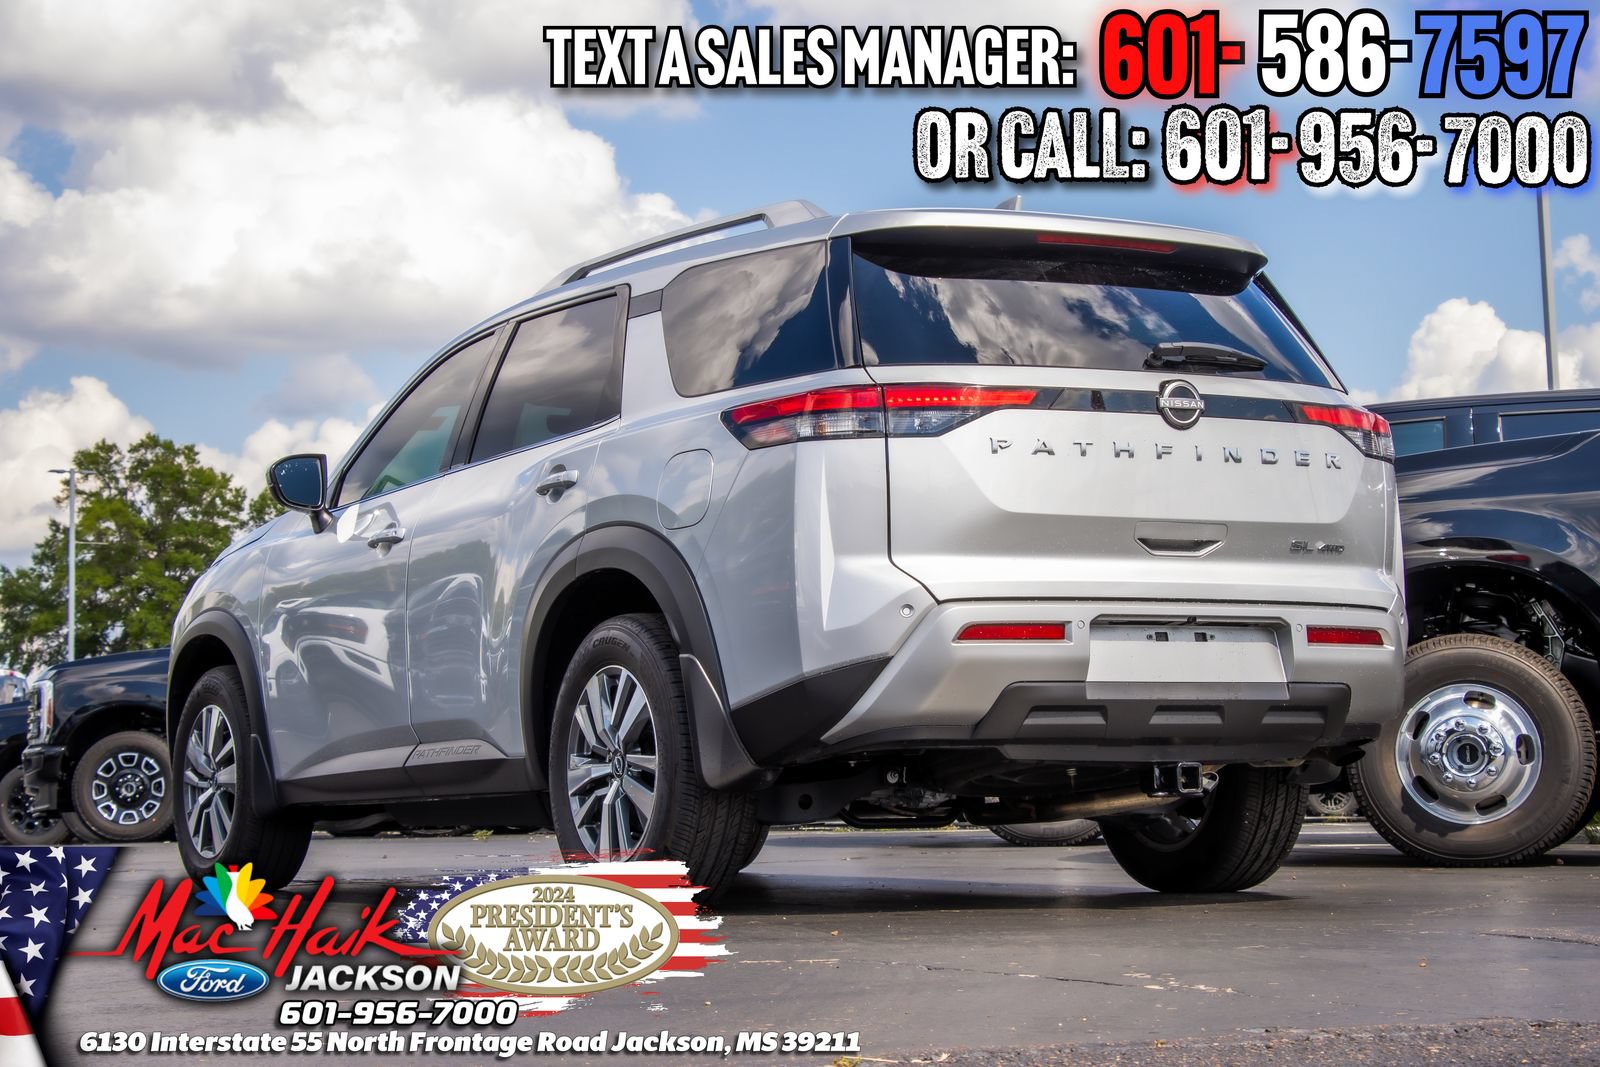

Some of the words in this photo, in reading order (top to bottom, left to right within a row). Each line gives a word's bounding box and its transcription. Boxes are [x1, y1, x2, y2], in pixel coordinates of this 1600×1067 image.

[1160, 398, 1205, 409] NISSAN
[989, 437, 1342, 469] PATHFINDER
[1290, 540, 1314, 554] SL
[412, 744, 482, 760] PATHFINDER
